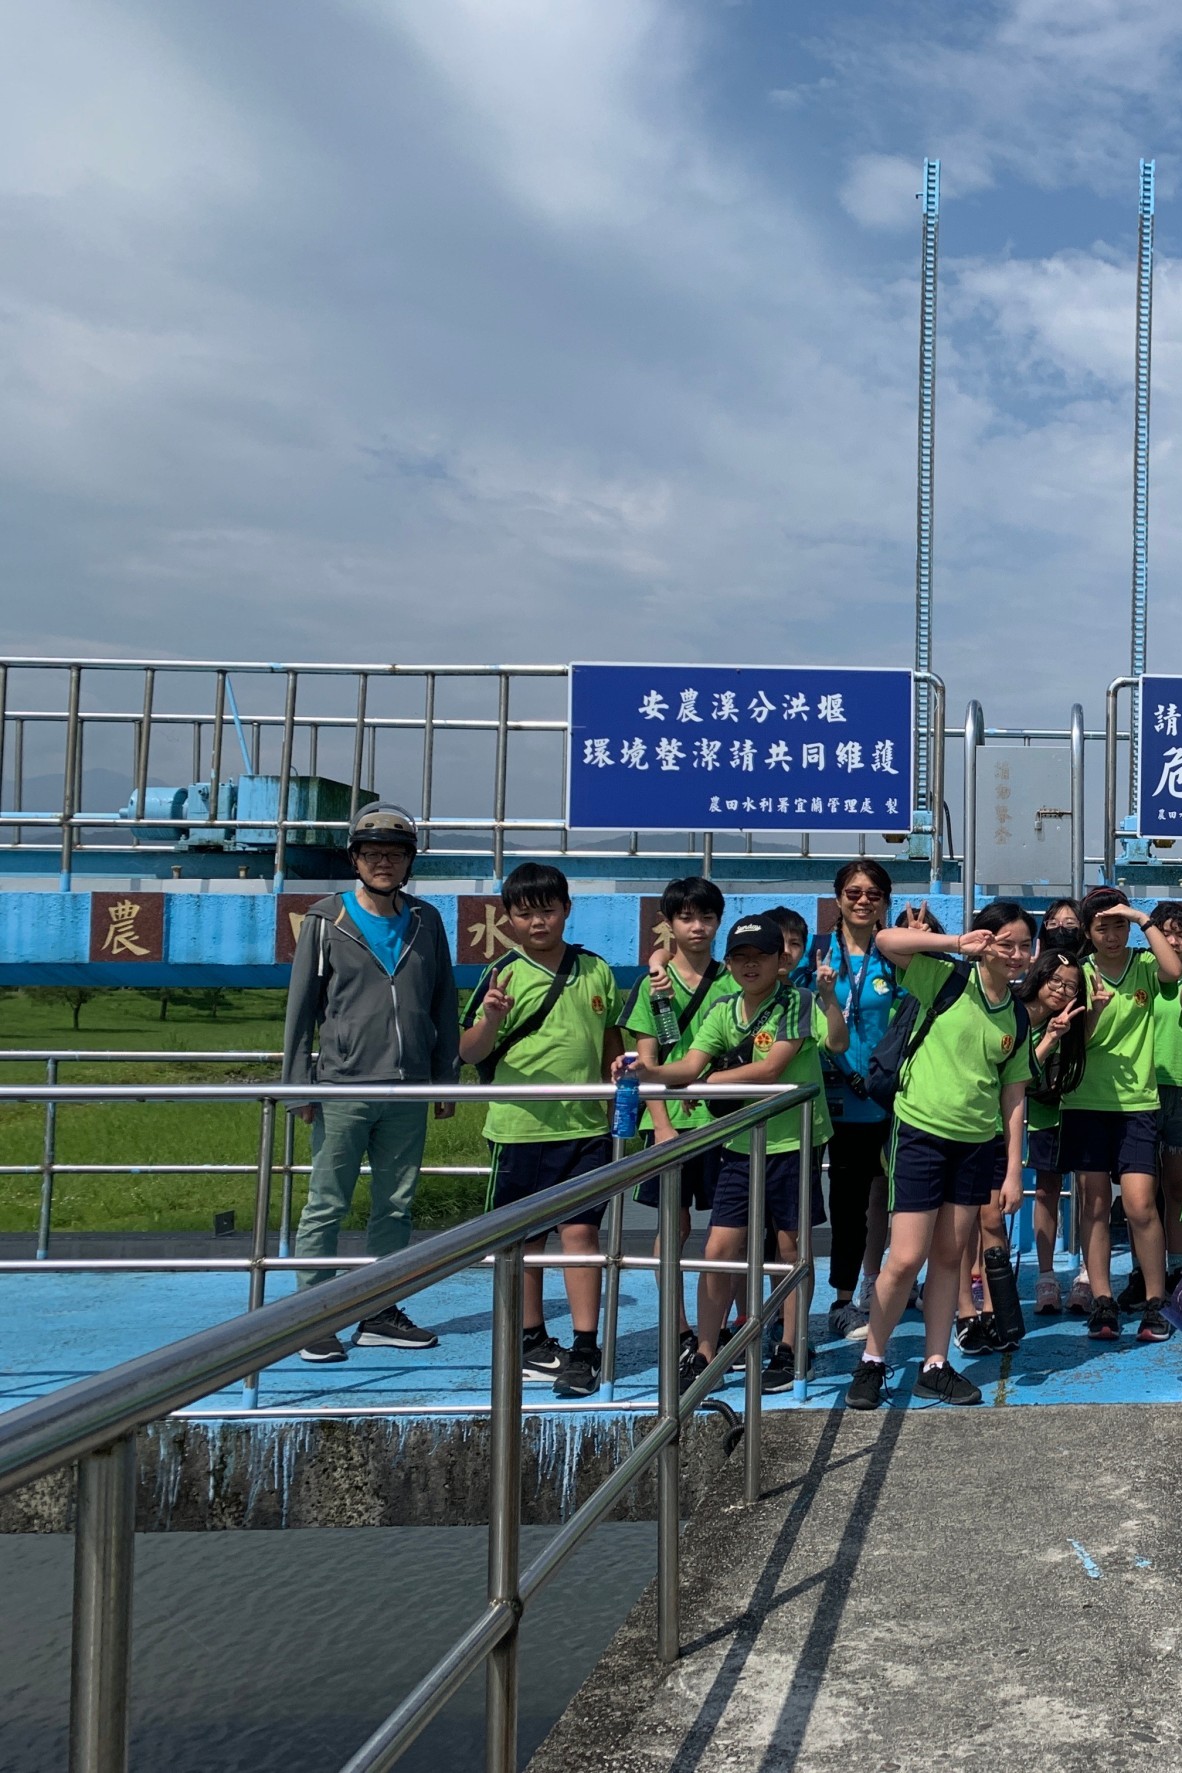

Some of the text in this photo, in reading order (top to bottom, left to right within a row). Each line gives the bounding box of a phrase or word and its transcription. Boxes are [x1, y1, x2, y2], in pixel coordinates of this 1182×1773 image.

[638, 687, 847, 723] 安農溪分洪堰
[583, 737, 899, 775] 環境整潔請共同維護
[708, 795, 899, 815] 農田水利署宜蘭管理處 製
[101, 899, 151, 956] 農
